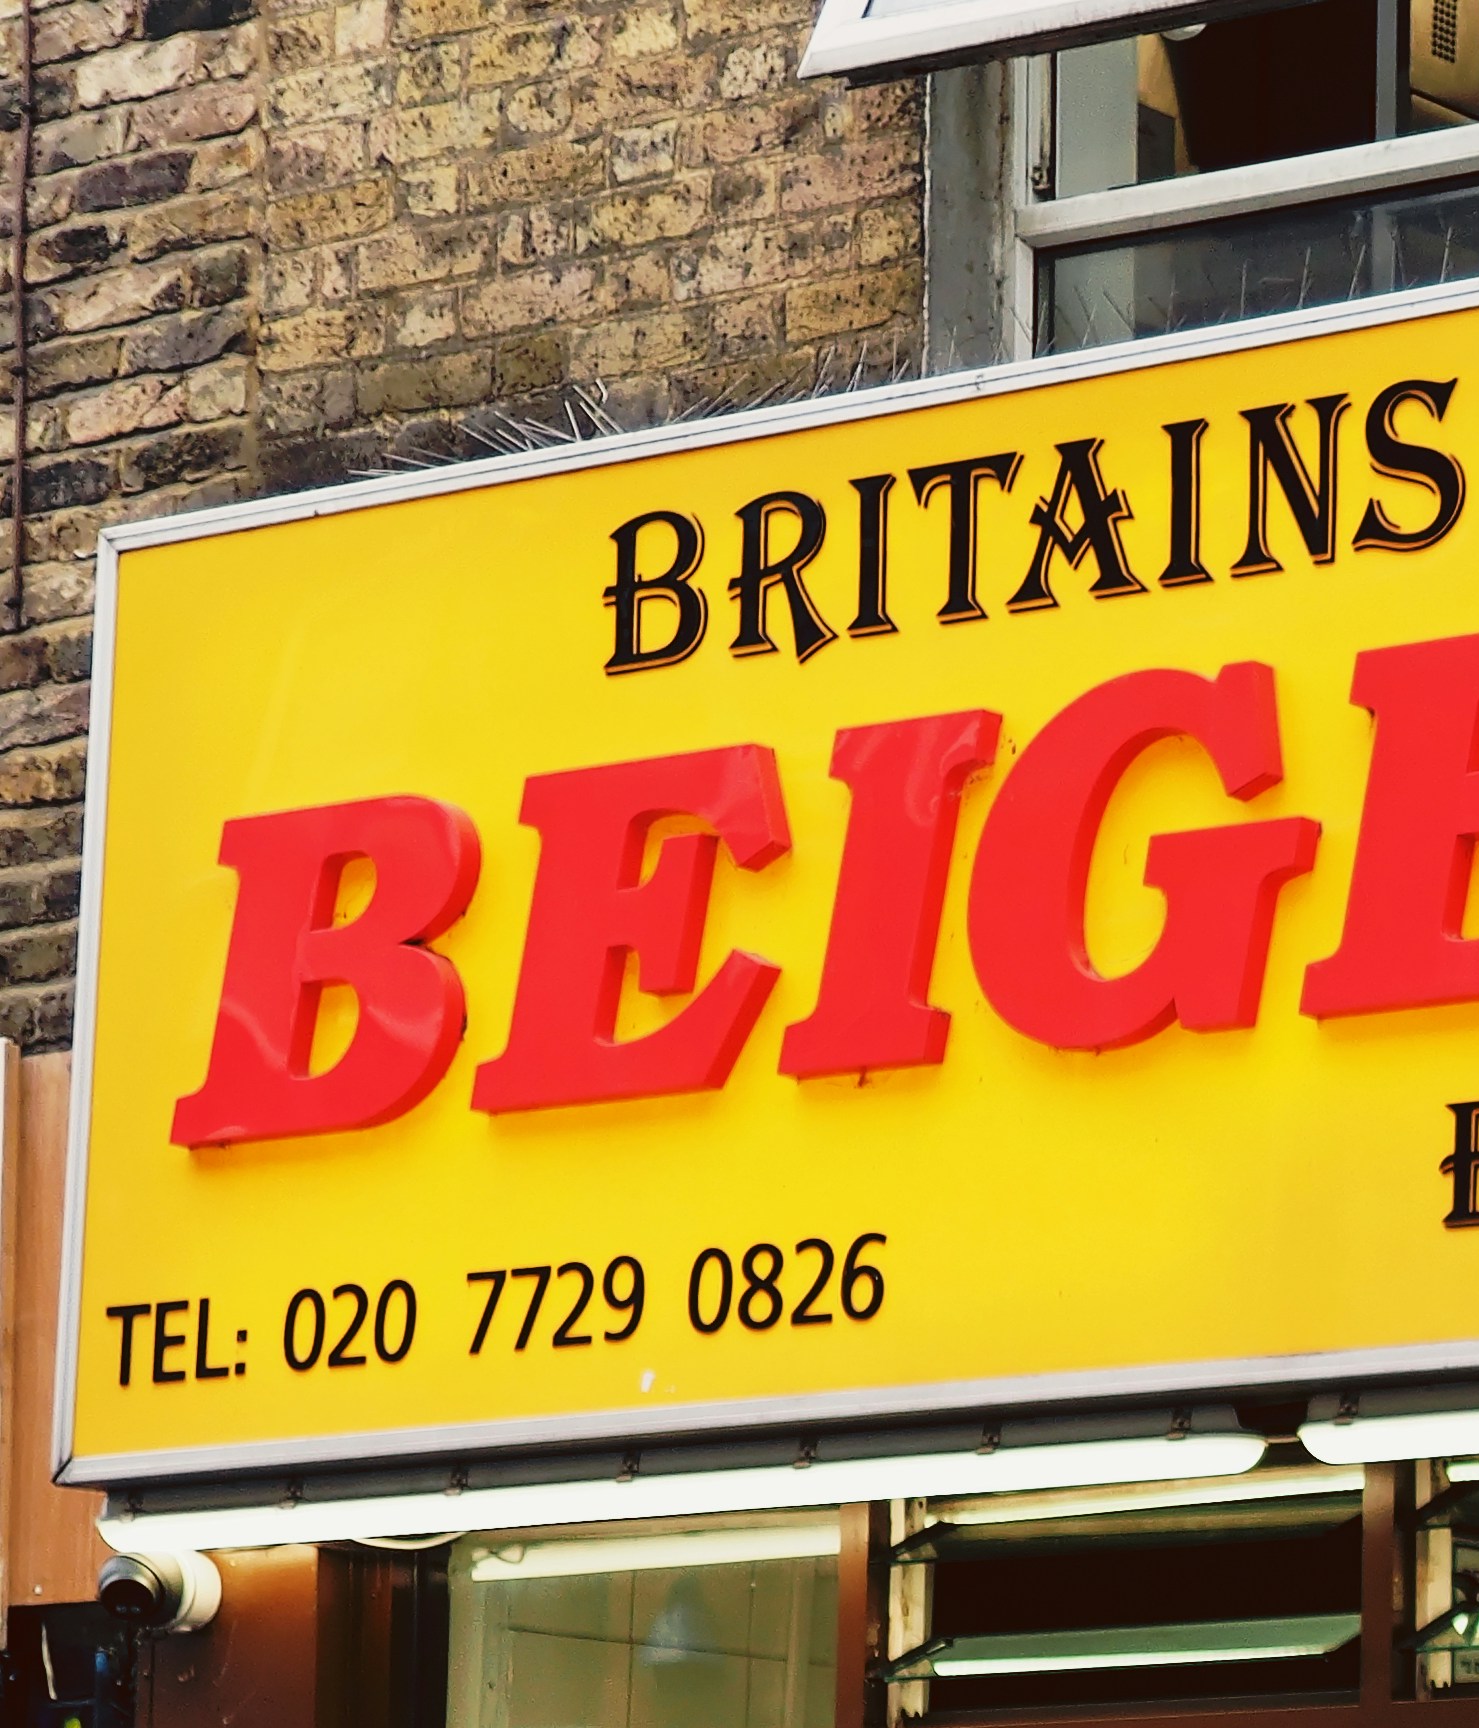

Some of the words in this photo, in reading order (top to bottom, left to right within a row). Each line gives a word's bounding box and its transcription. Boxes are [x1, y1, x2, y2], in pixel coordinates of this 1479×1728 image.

[602, 375, 1466, 677] BRITAINS
[106, 1297, 248, 1387] TEL:
[282, 1278, 418, 1372] 020
[466, 1254, 646, 1355] 7729
[687, 1231, 888, 1335] 0826
